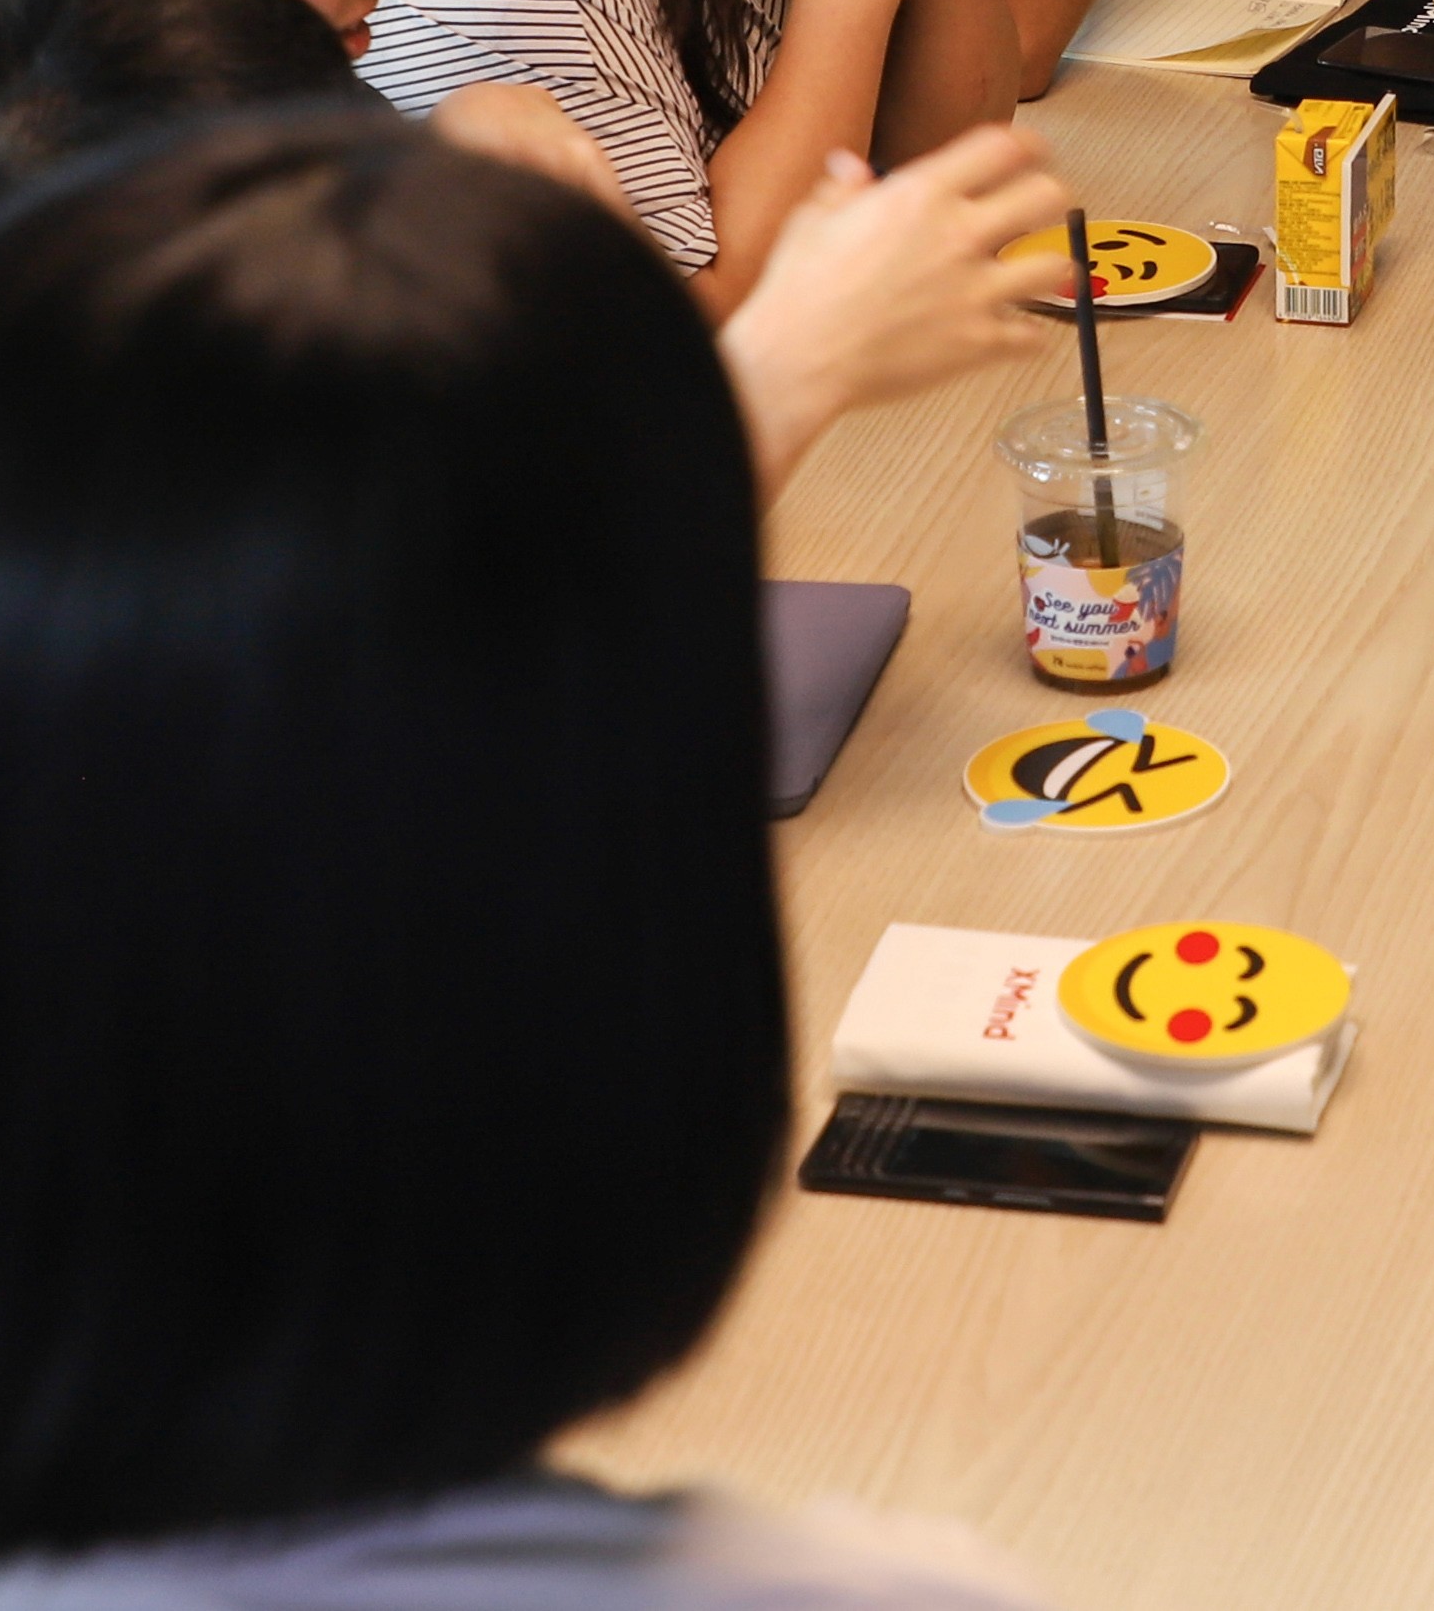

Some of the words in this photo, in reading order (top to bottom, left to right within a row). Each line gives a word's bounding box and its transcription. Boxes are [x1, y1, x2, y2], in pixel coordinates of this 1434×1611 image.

[1044, 591, 1075, 613] See
[1079, 602, 1117, 621] you
[1029, 608, 1060, 630] next
[1064, 619, 1140, 636] summer
[982, 966, 1041, 1041] XMind
